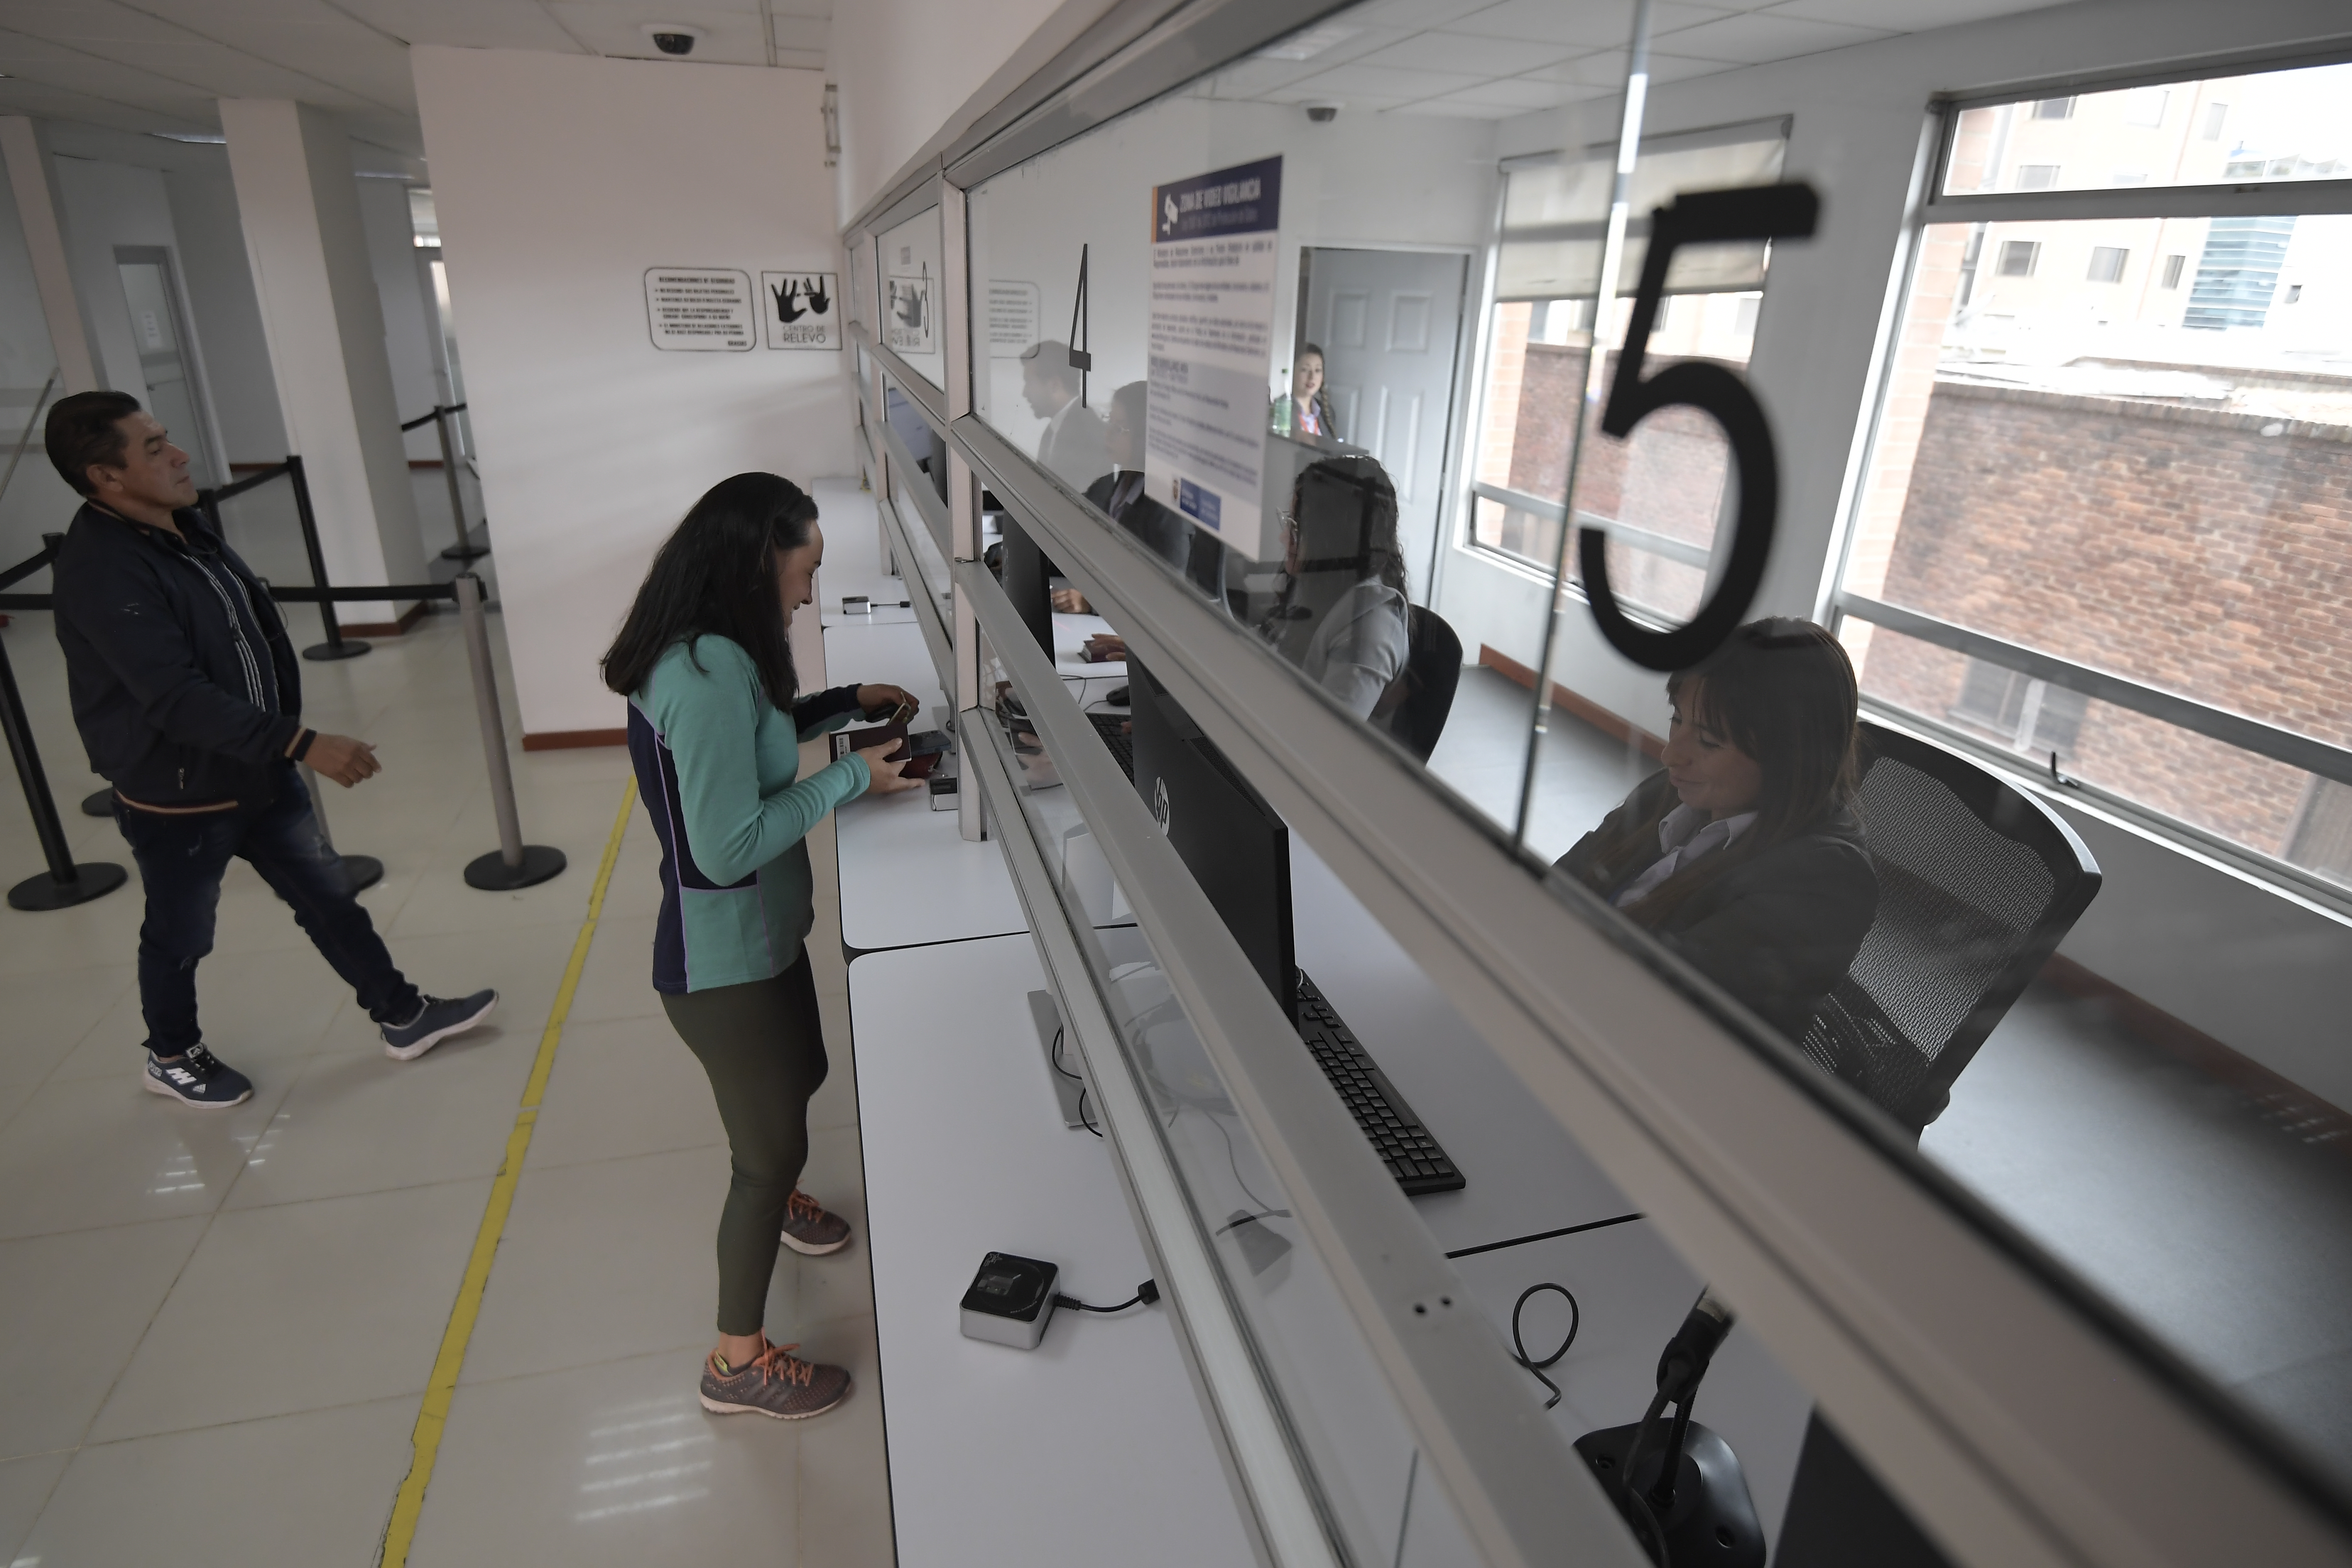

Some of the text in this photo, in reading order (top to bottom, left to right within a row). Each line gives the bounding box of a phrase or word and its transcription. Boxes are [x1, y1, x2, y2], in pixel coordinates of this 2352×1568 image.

[784, 333, 826, 343] RELEVO
[1069, 243, 1091, 408] 4
[1579, 182, 1821, 673] 5
